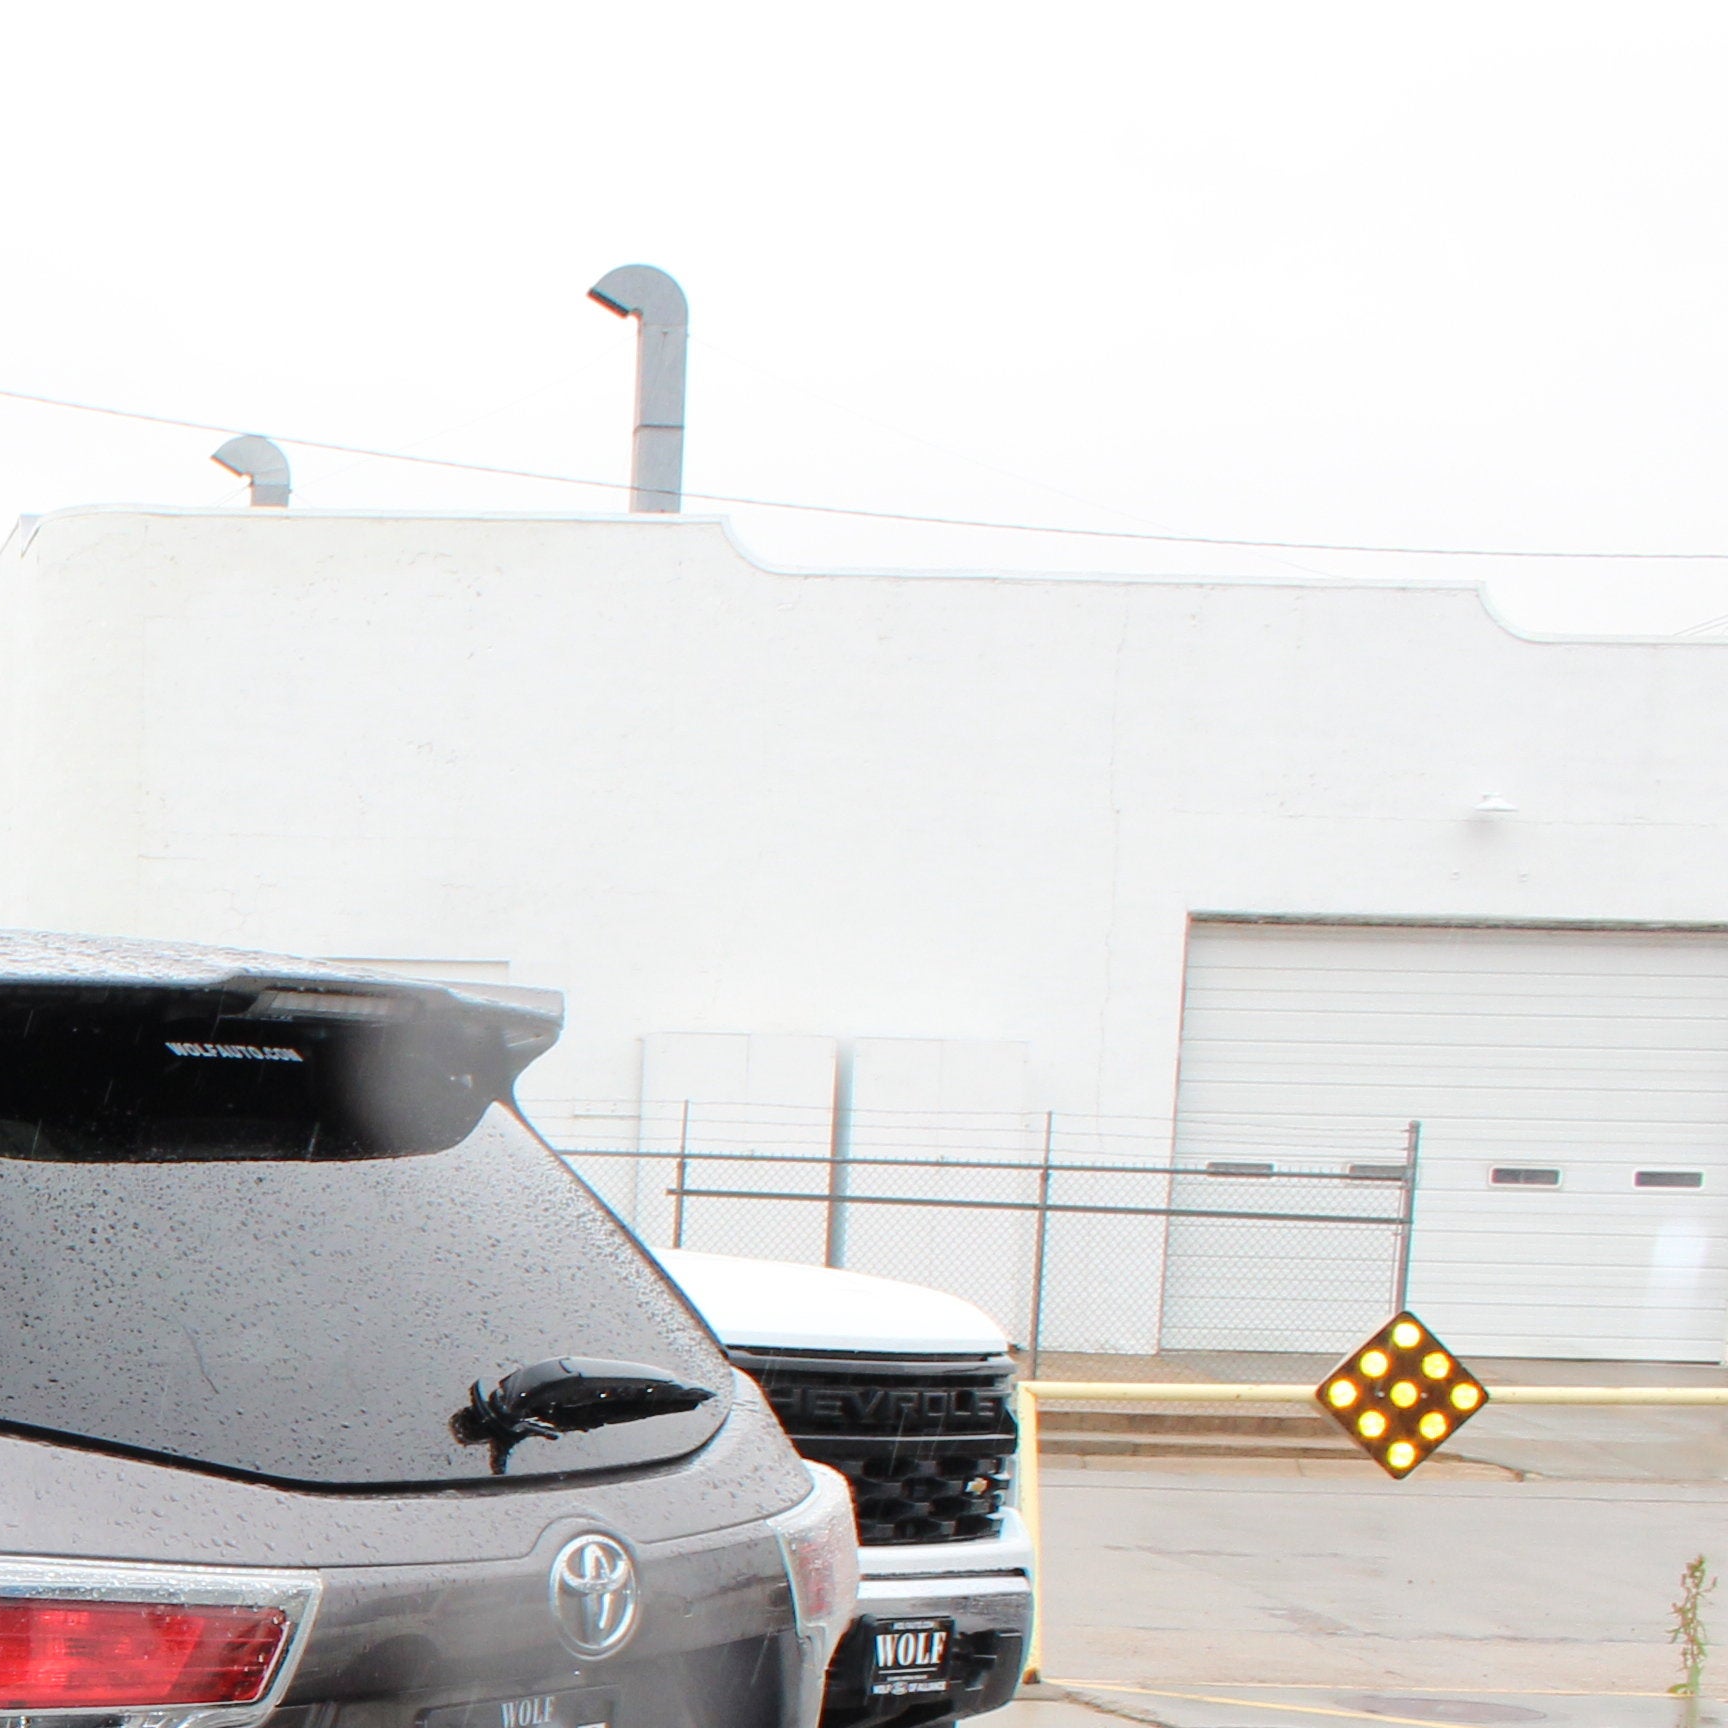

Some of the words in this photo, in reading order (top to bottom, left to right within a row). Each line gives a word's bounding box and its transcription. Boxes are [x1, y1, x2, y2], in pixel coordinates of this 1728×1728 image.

[164, 1042, 304, 1062] WOLFAUTO.COM
[875, 1631, 948, 1668] WOLF
[500, 1696, 555, 1728] WOLF
